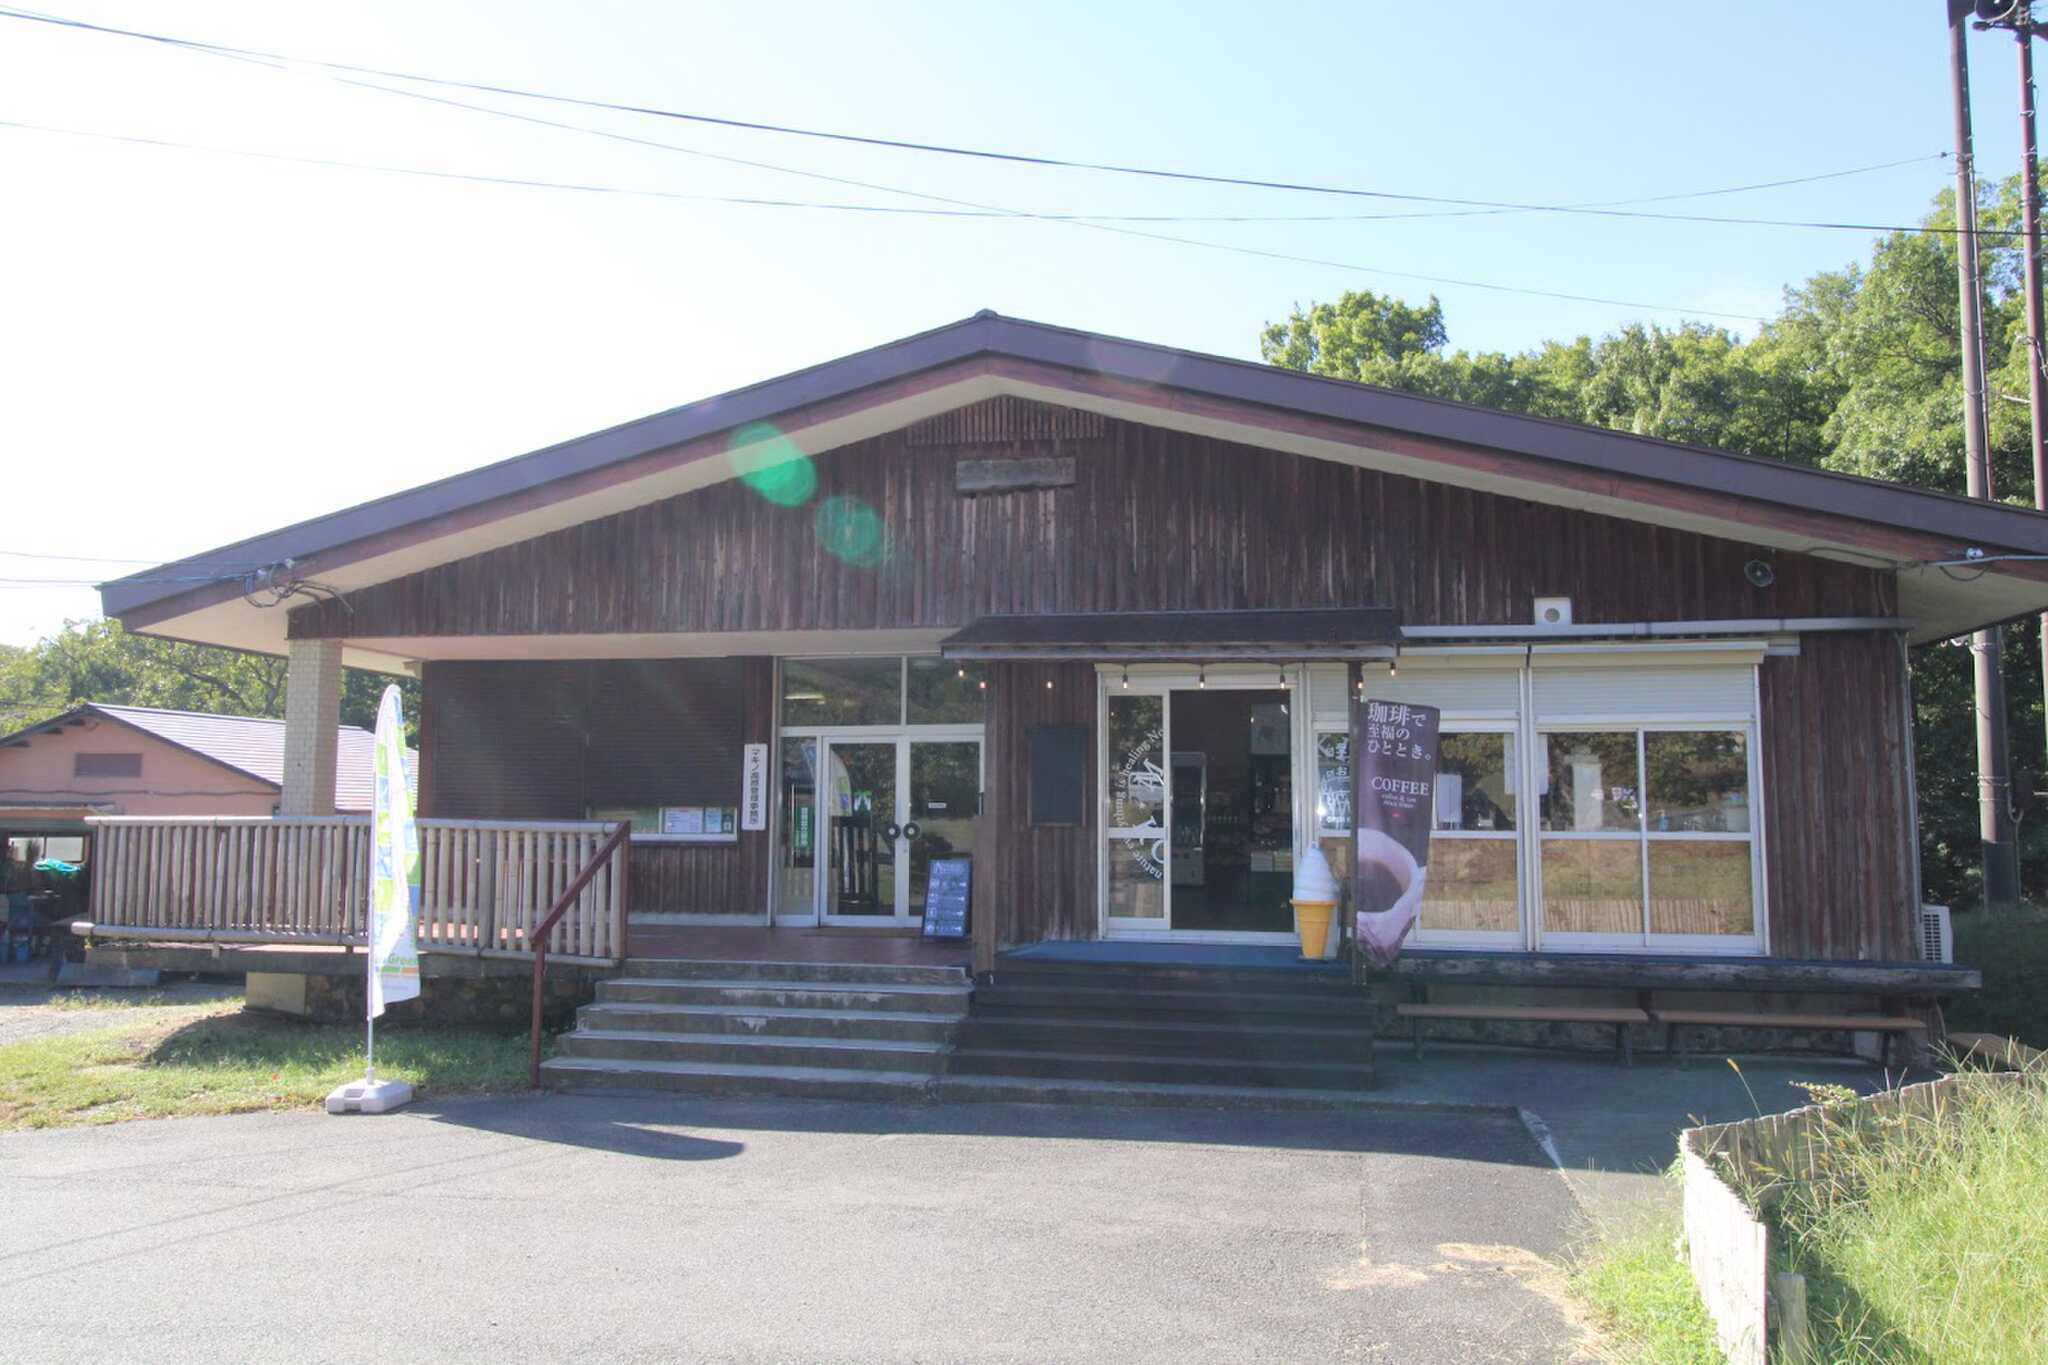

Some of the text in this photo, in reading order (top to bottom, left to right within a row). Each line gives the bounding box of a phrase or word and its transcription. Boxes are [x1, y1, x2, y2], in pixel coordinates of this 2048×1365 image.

[1368, 702, 1426, 727] 珈琲で
[1368, 722, 1410, 740] 至福の
[1368, 740, 1431, 760] ひととき。
[1371, 776, 1430, 796] COFFEE
